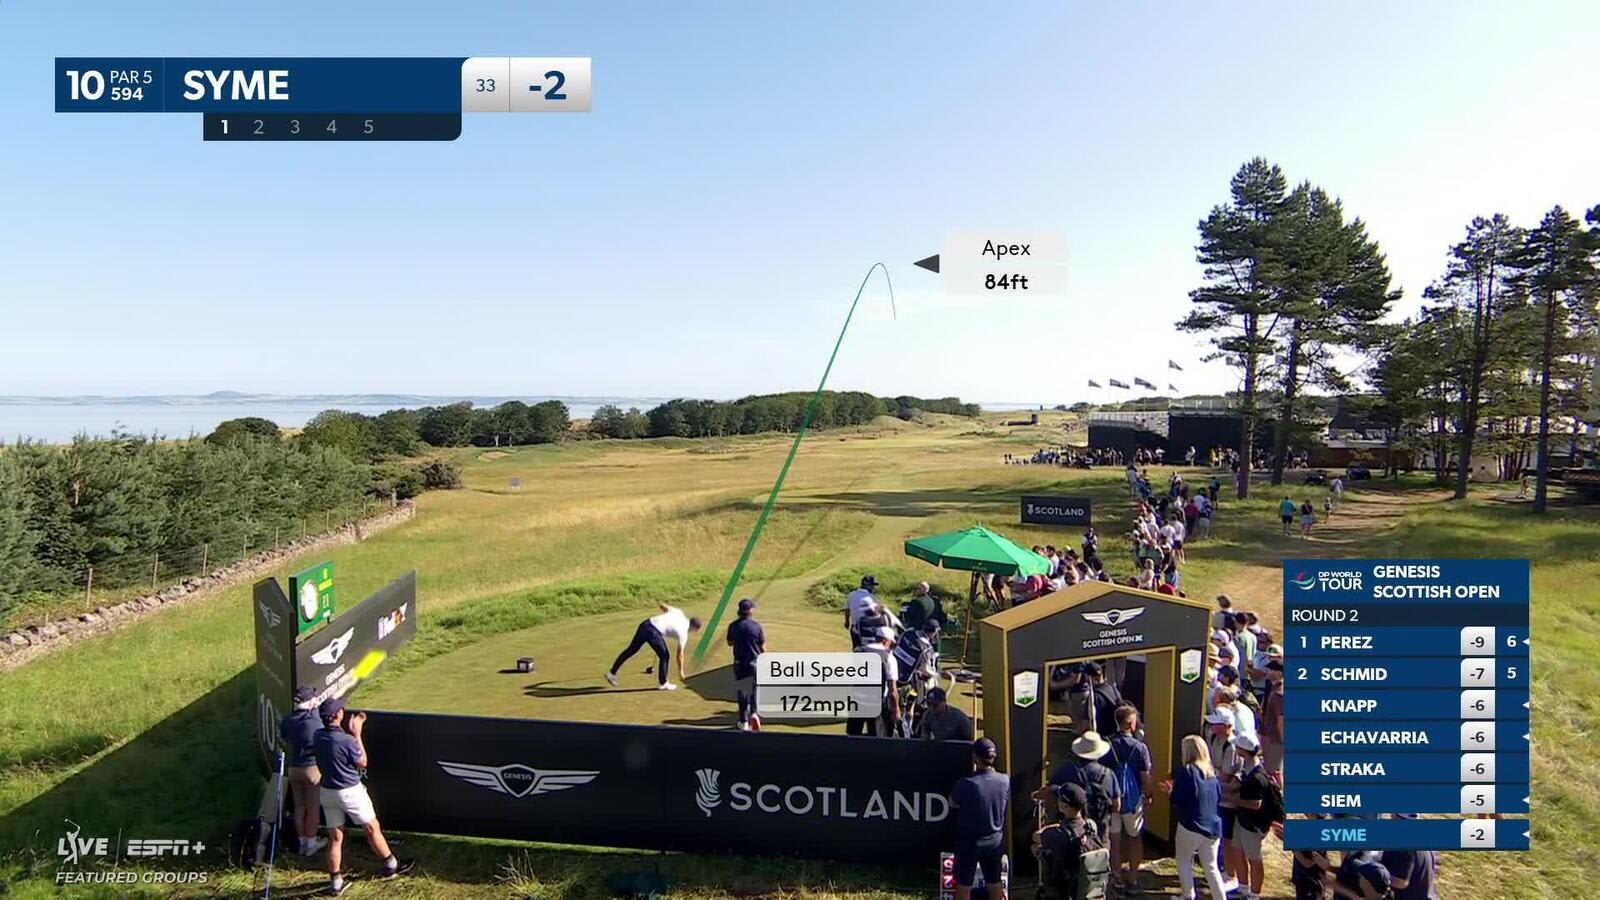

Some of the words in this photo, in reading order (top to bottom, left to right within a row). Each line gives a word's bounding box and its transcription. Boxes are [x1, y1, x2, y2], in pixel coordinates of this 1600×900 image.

[1034, 506, 1085, 516] SCOTLAND
[1099, 628, 1127, 638] GENESIS
[1082, 637, 1116, 649] SCOTTISH
[503, 772, 532, 781] GENESIS
[729, 781, 950, 823] SCOTLAND
